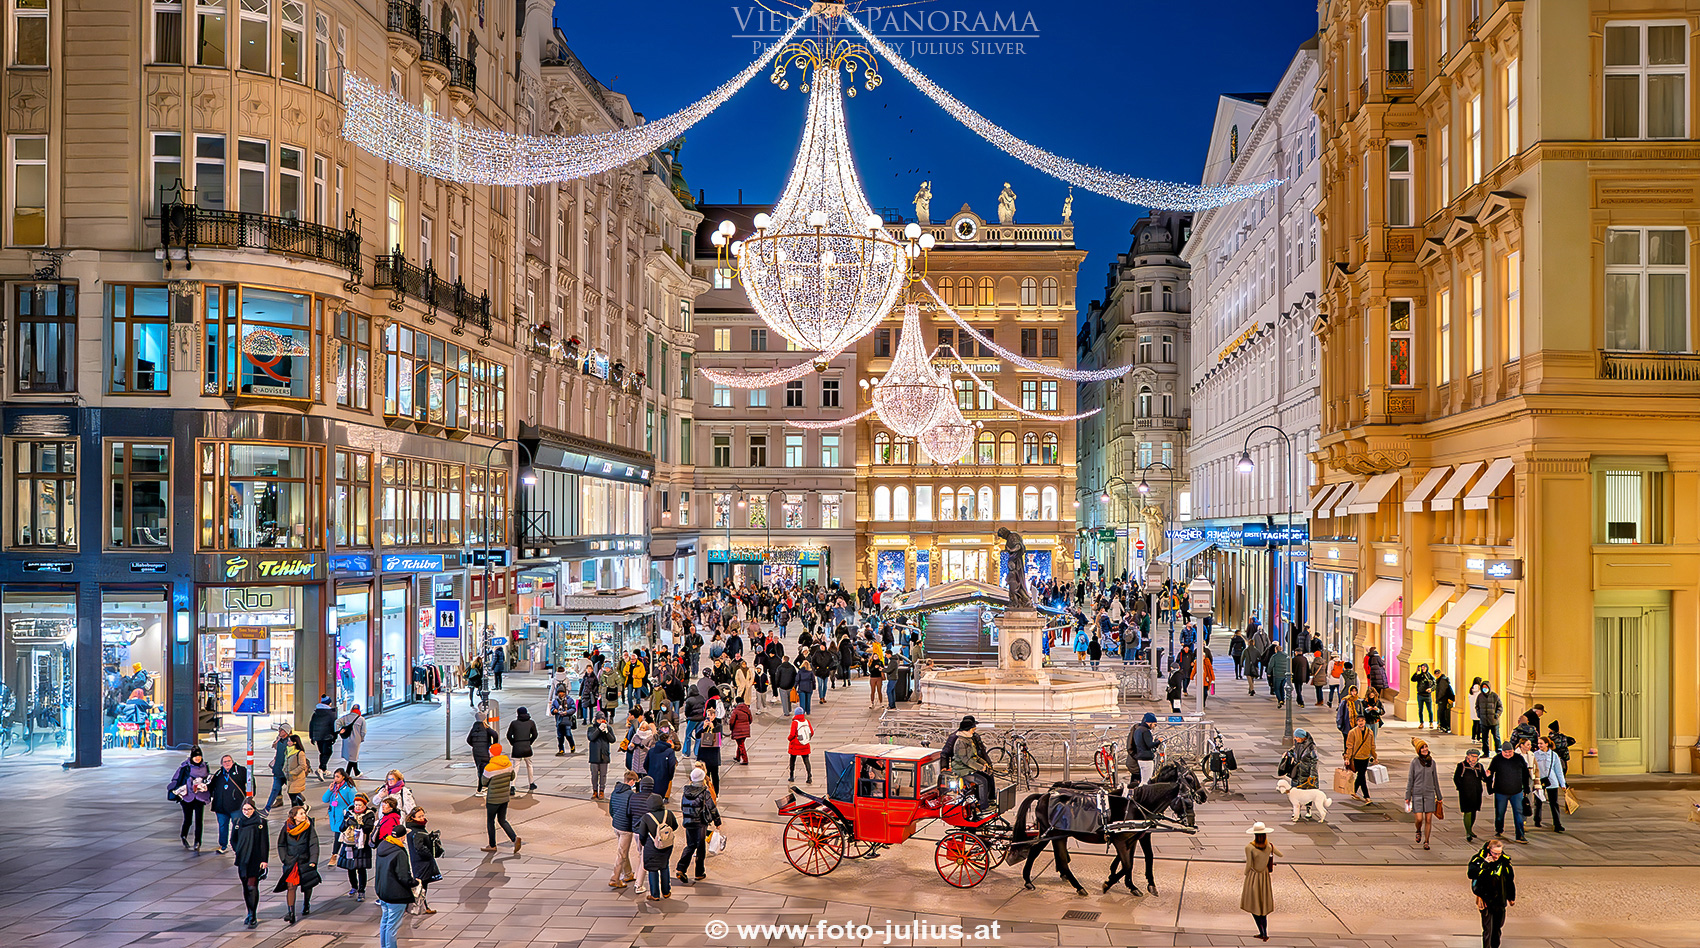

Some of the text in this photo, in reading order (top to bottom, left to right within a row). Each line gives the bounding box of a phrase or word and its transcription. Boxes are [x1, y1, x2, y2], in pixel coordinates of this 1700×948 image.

[932, 364, 958, 372] LOIS
[258, 560, 317, 576] Tchibo
[402, 560, 440, 570] Tchibo
[224, 588, 272, 611] Qbo
